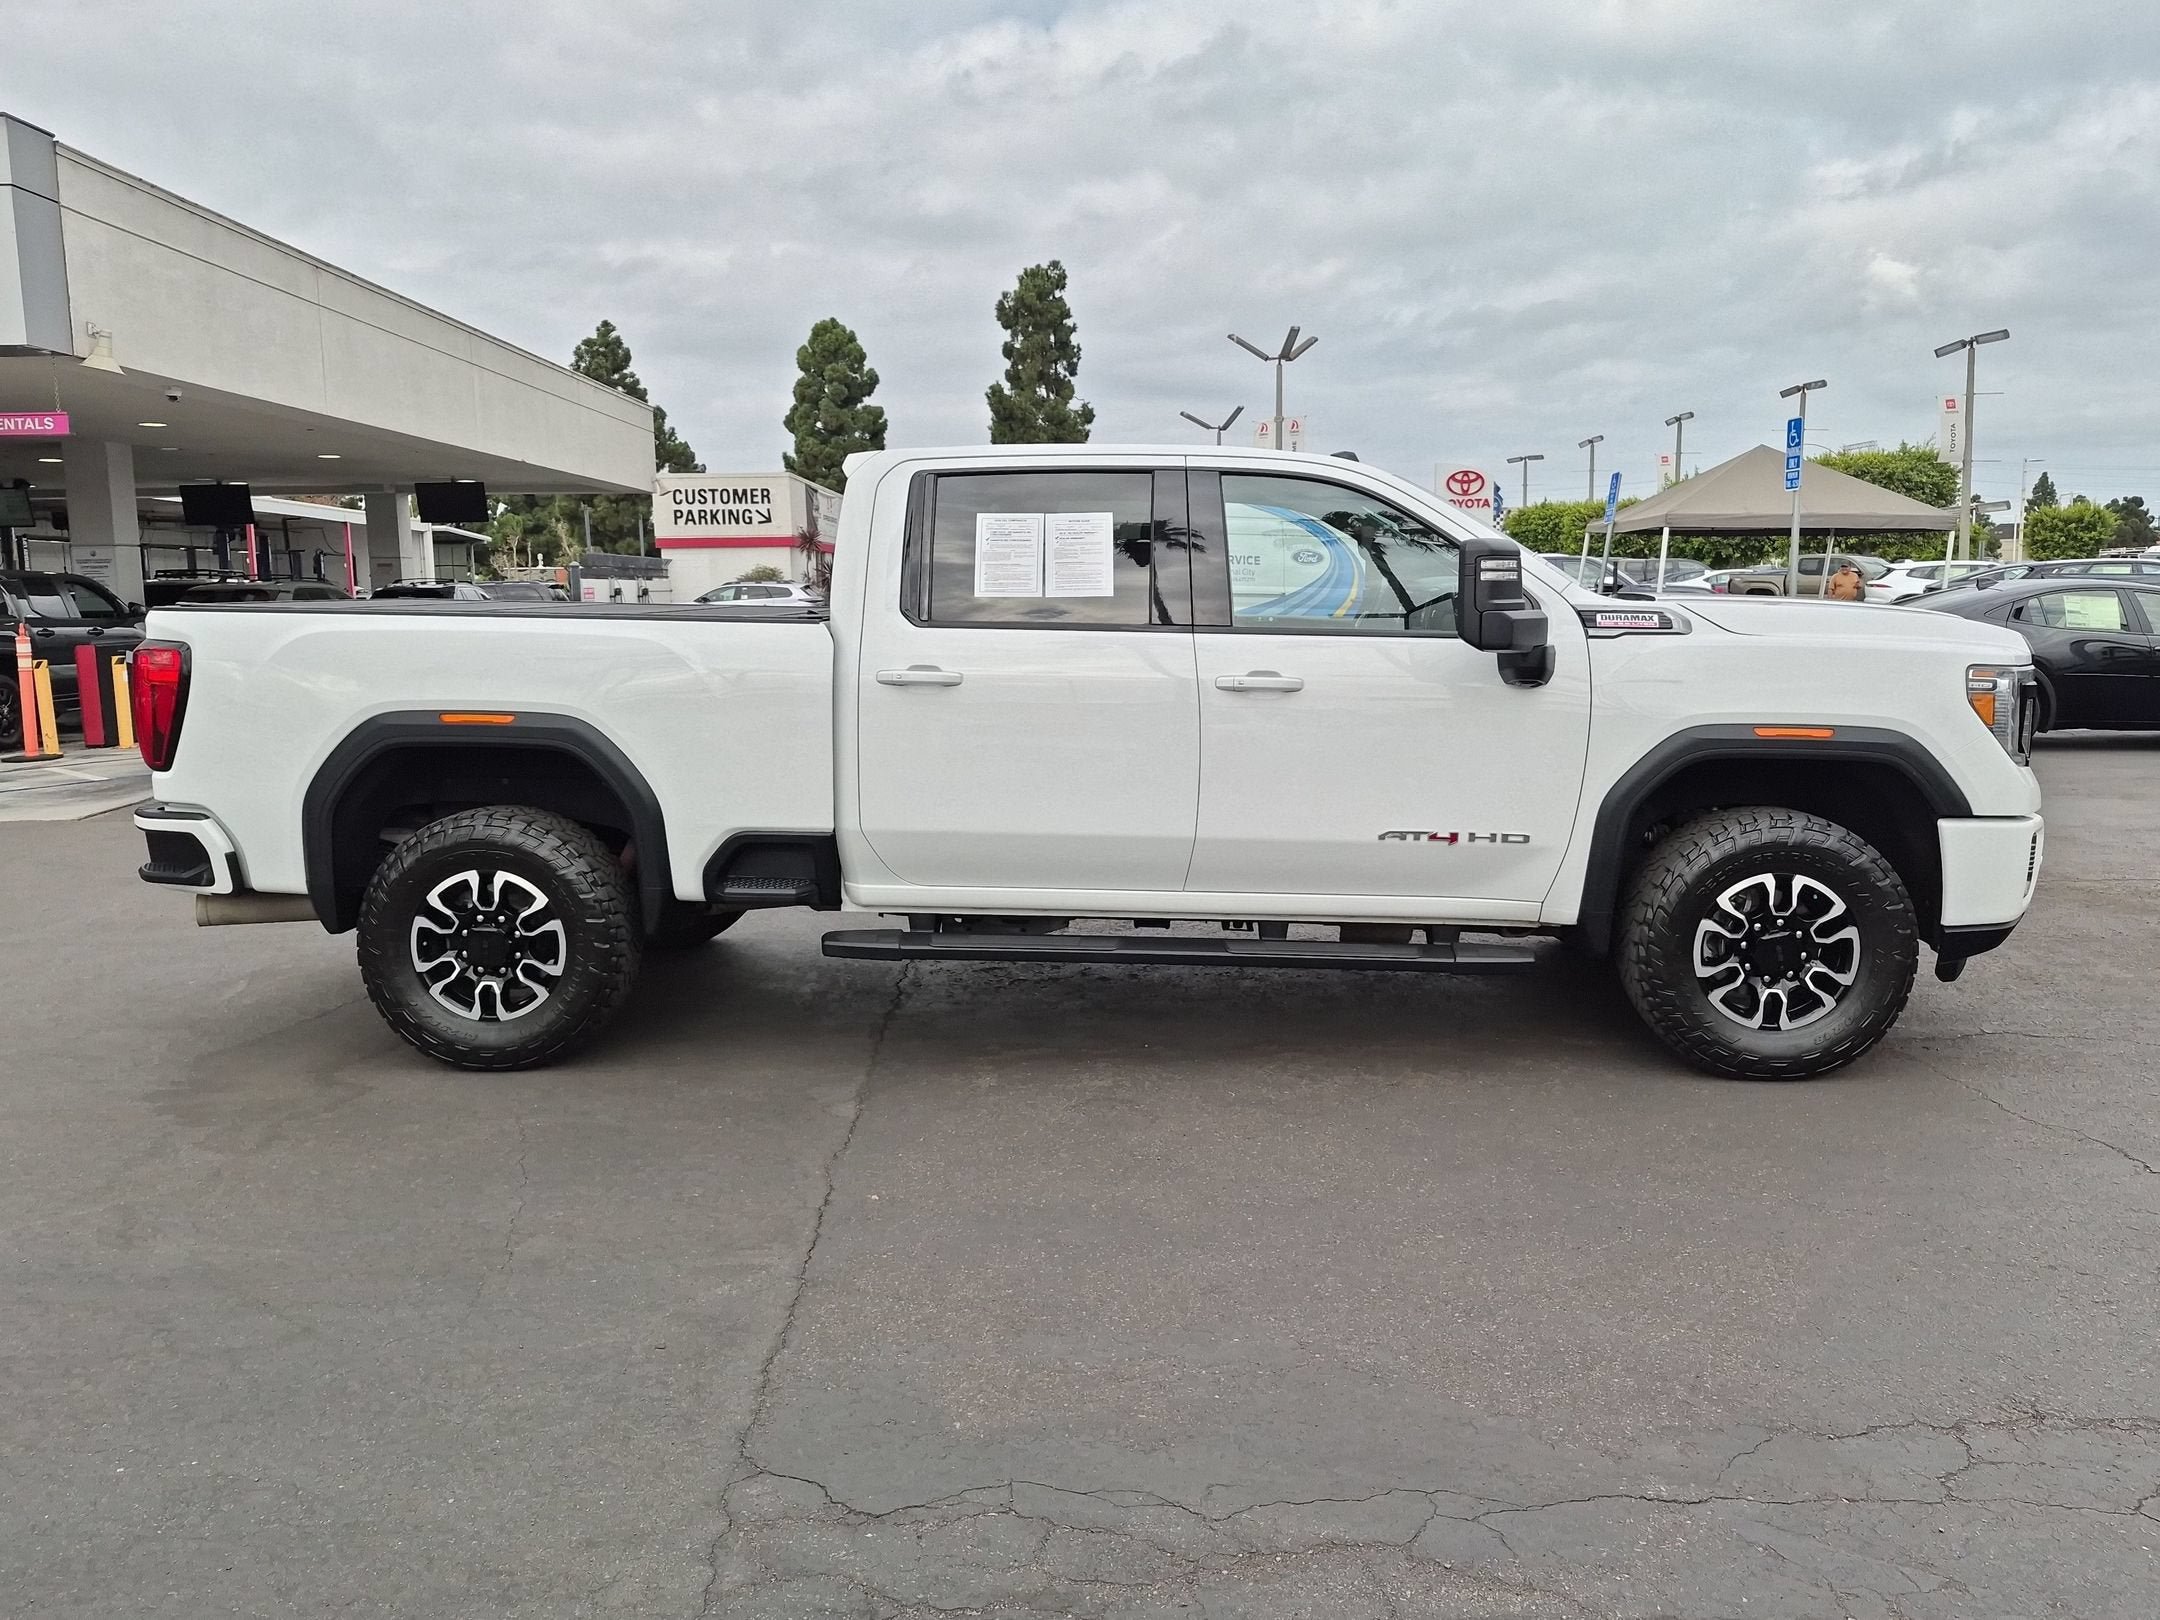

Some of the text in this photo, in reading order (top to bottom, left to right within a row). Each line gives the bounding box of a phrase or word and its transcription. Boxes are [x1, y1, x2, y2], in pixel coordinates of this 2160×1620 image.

[672, 488, 771, 505] CUSTOMER
[673, 508, 753, 526] PARKING
[1600, 614, 1654, 622] DURAMAX
[1378, 830, 1530, 846] AT4 HD
